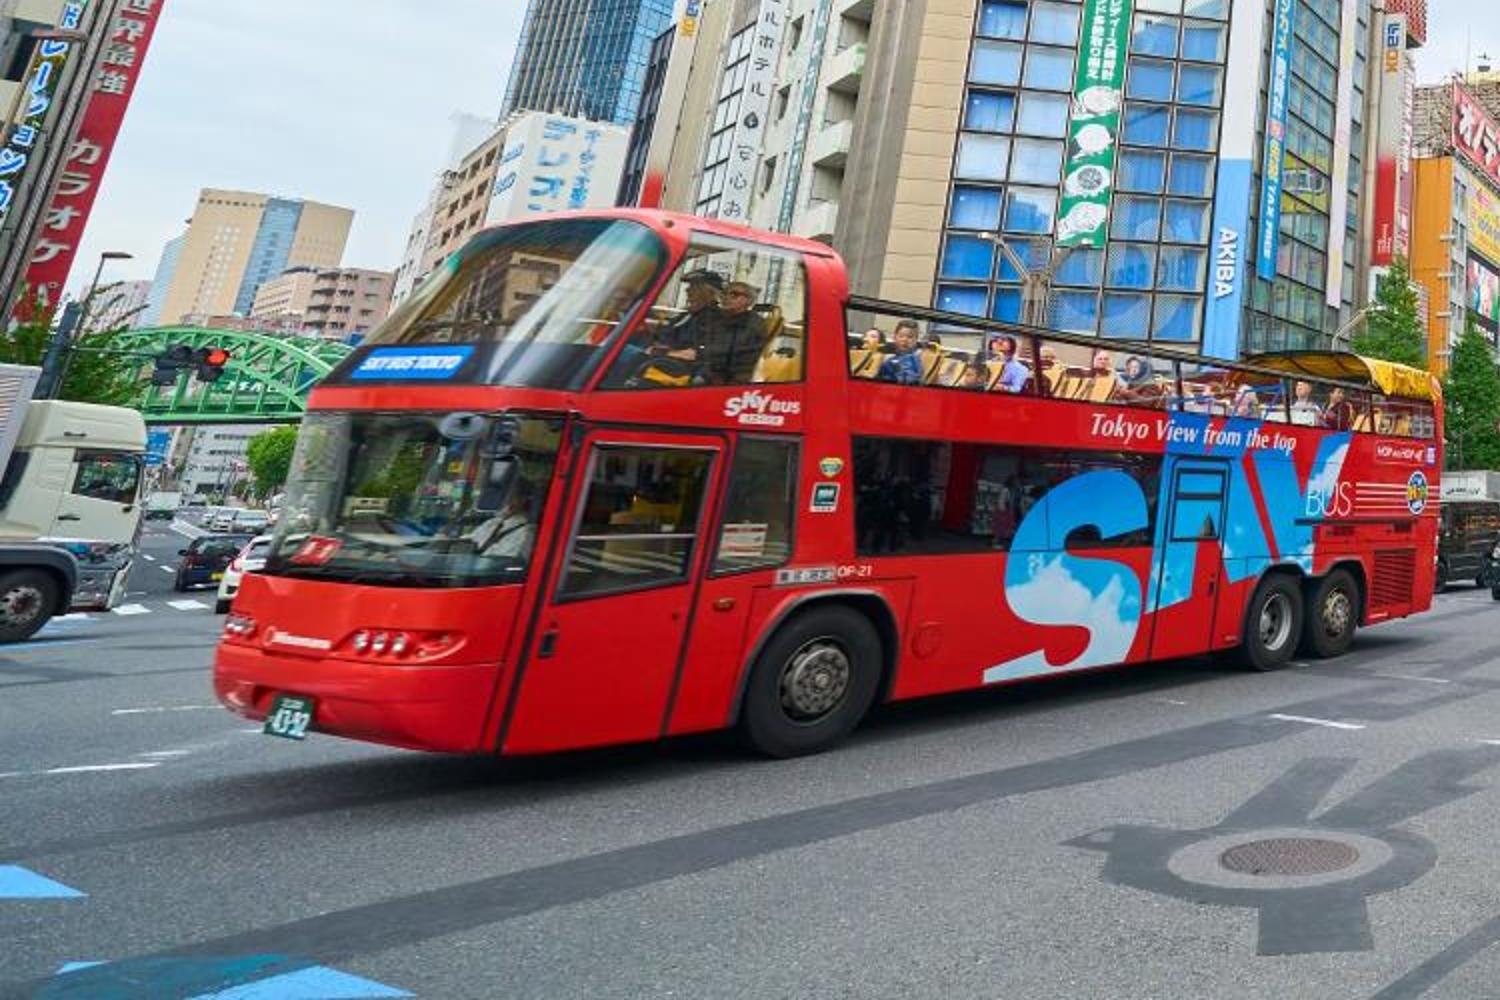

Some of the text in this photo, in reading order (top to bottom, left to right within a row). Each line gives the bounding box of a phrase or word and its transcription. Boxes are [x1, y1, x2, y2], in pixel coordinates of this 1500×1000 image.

[31, 138, 102, 265] カラオケ
[1215, 228, 1239, 298] AKIBA
[770, 400, 801, 414] BUS
[1090, 413, 1297, 456] Tokyo View from the top
[1305, 481, 1352, 517] BUS
